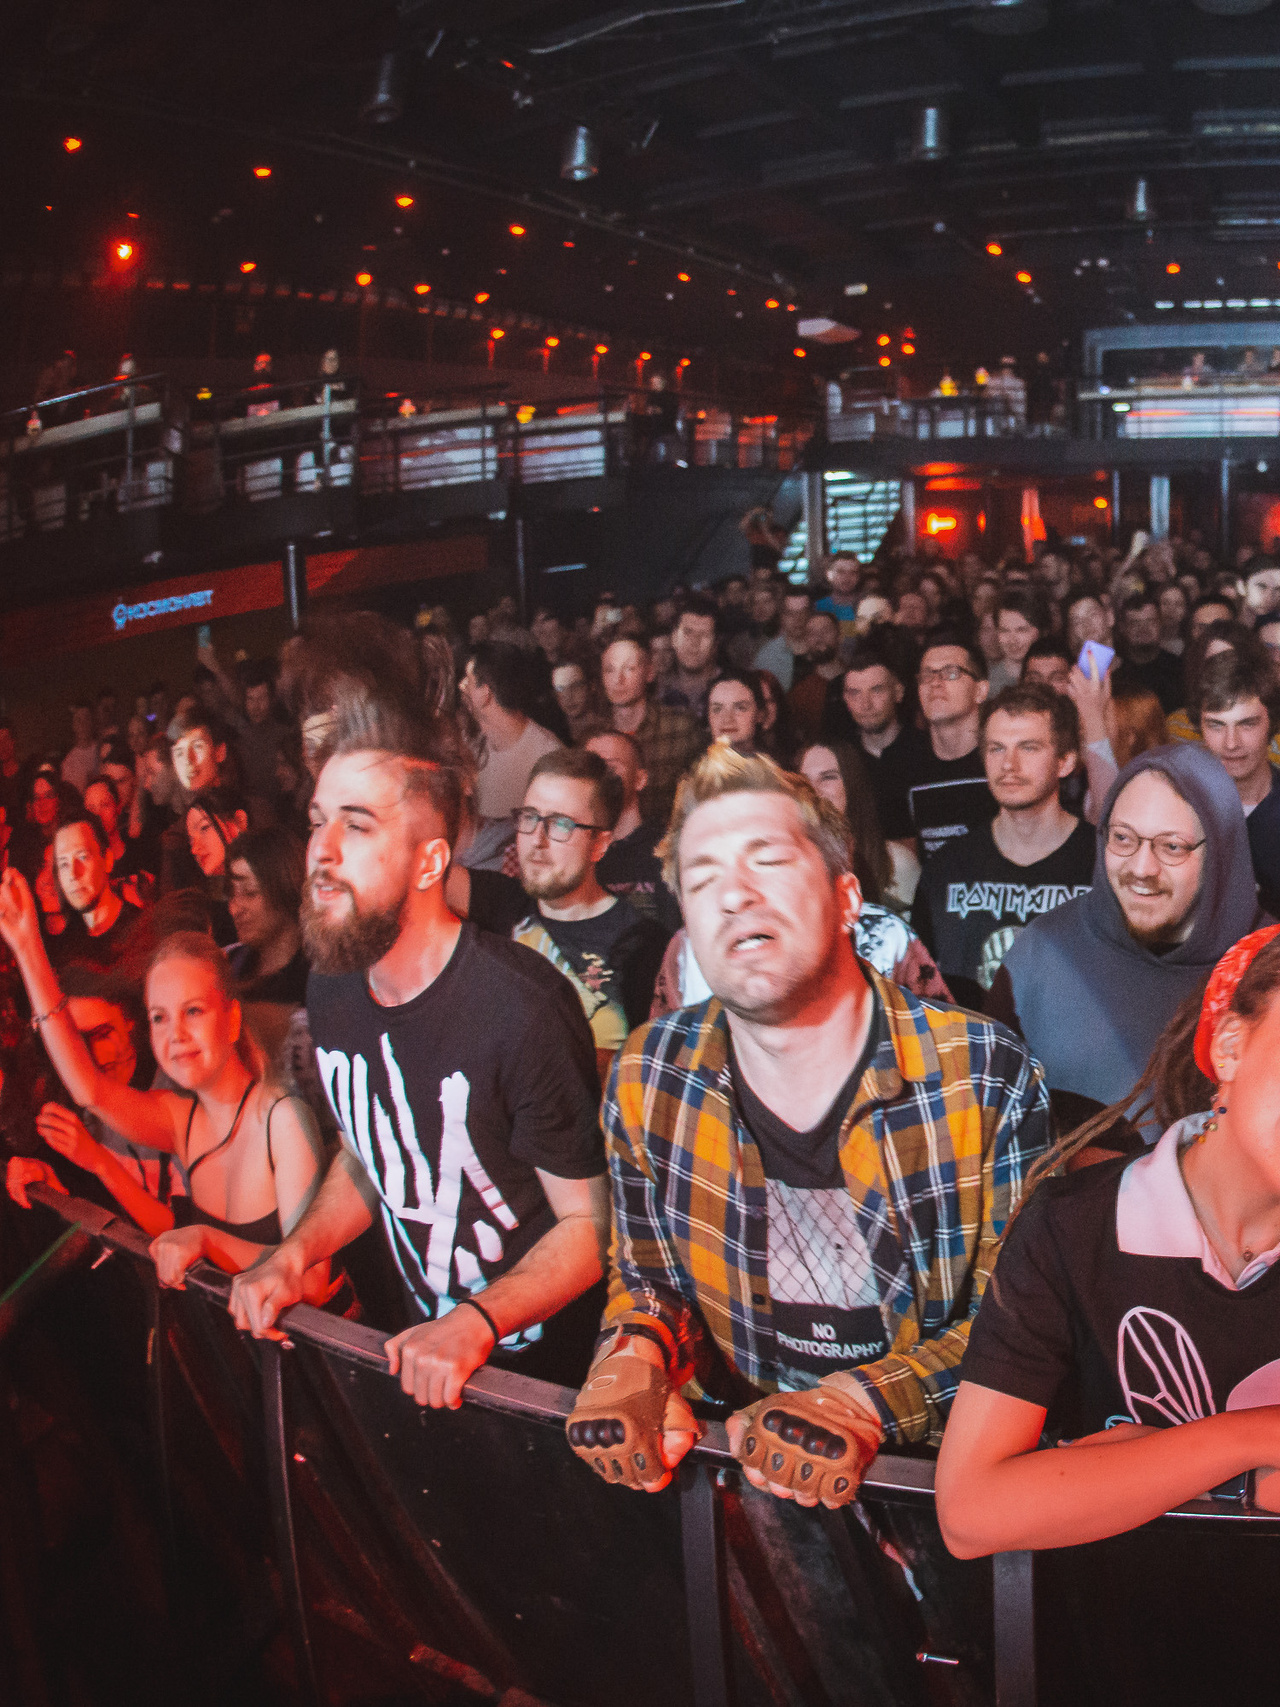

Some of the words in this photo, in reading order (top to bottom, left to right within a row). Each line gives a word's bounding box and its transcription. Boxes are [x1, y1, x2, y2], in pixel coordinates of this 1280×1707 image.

[947, 882, 1005, 920] IRON
[776, 1330, 884, 1359] PHOTOGRAPHY
[811, 1322, 837, 1341] NO
